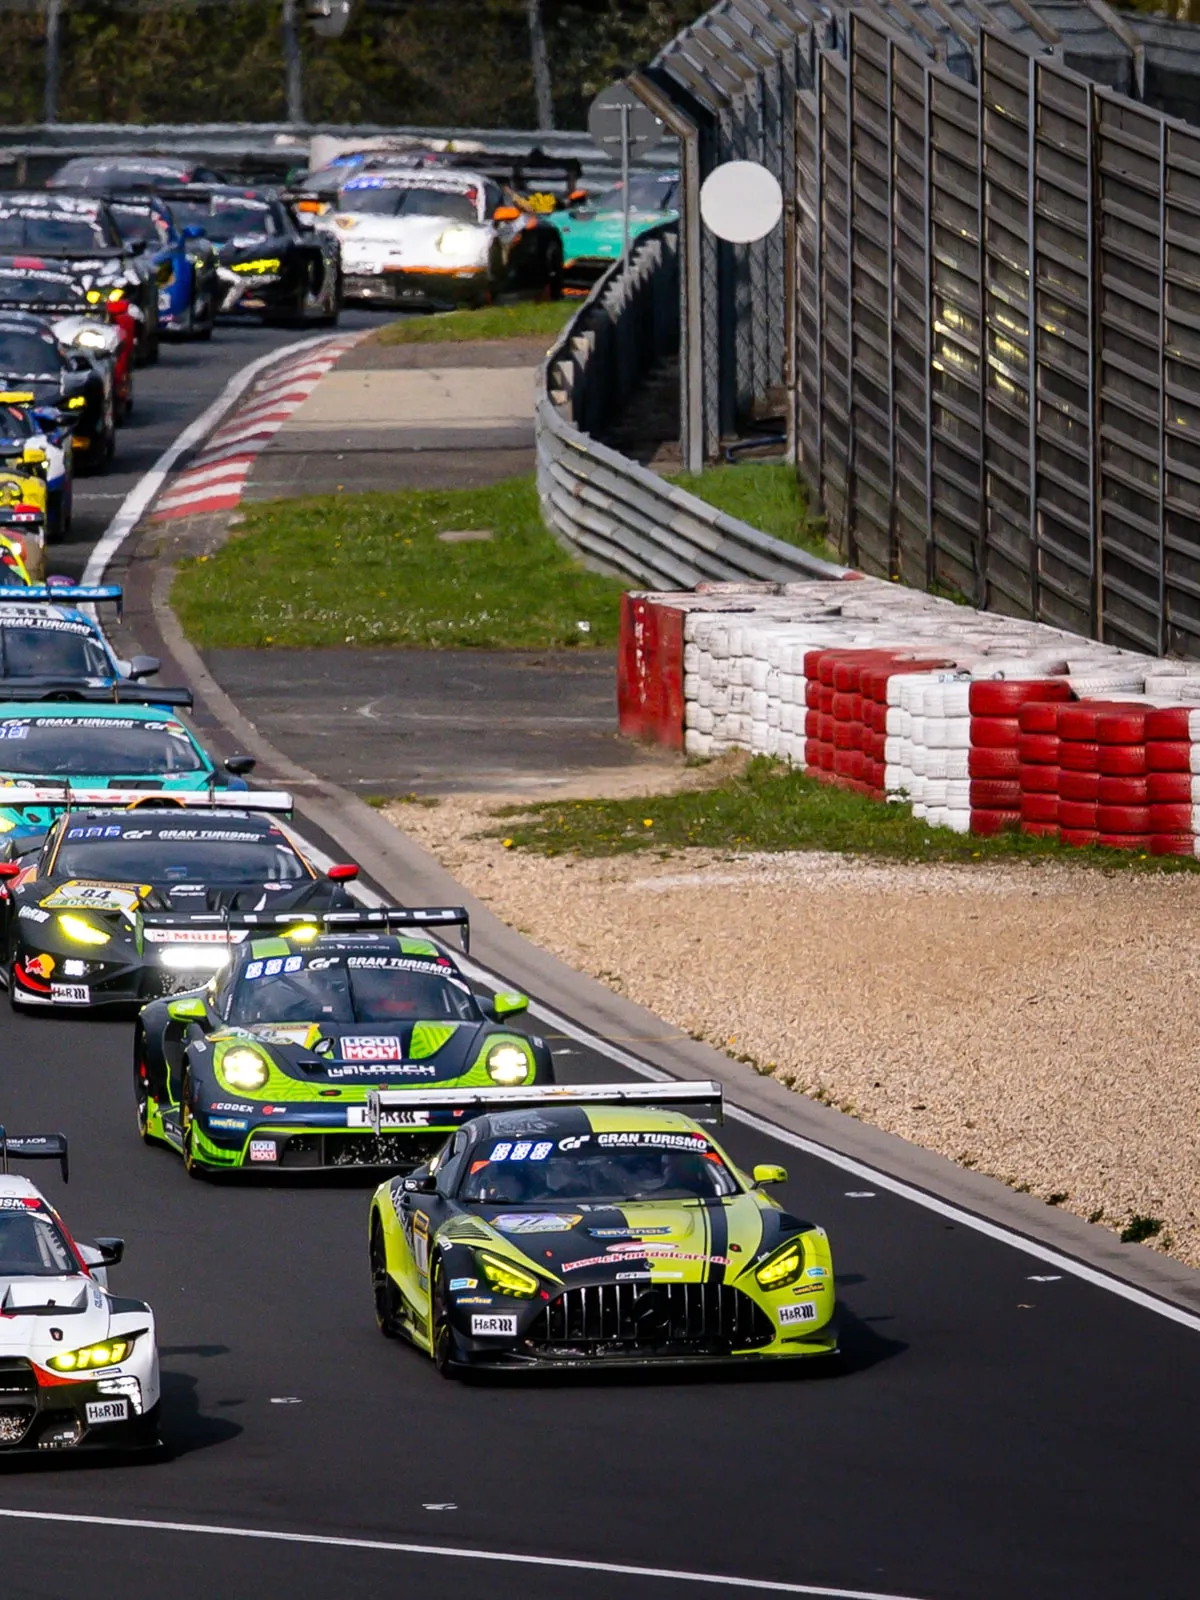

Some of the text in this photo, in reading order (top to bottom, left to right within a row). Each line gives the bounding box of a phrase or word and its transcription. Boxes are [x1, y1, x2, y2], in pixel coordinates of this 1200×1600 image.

[36, 718, 135, 728] GRAN TURISMO
[158, 830, 261, 841] GRAN TURISMO
[80, 888, 111, 899] 84
[347, 956, 387, 968] GRAN
[390, 958, 452, 976] TURISMO
[344, 1038, 396, 1047] LIQUI
[345, 1047, 397, 1059] MOLY
[597, 1133, 707, 1150] GRAN TURISMO
